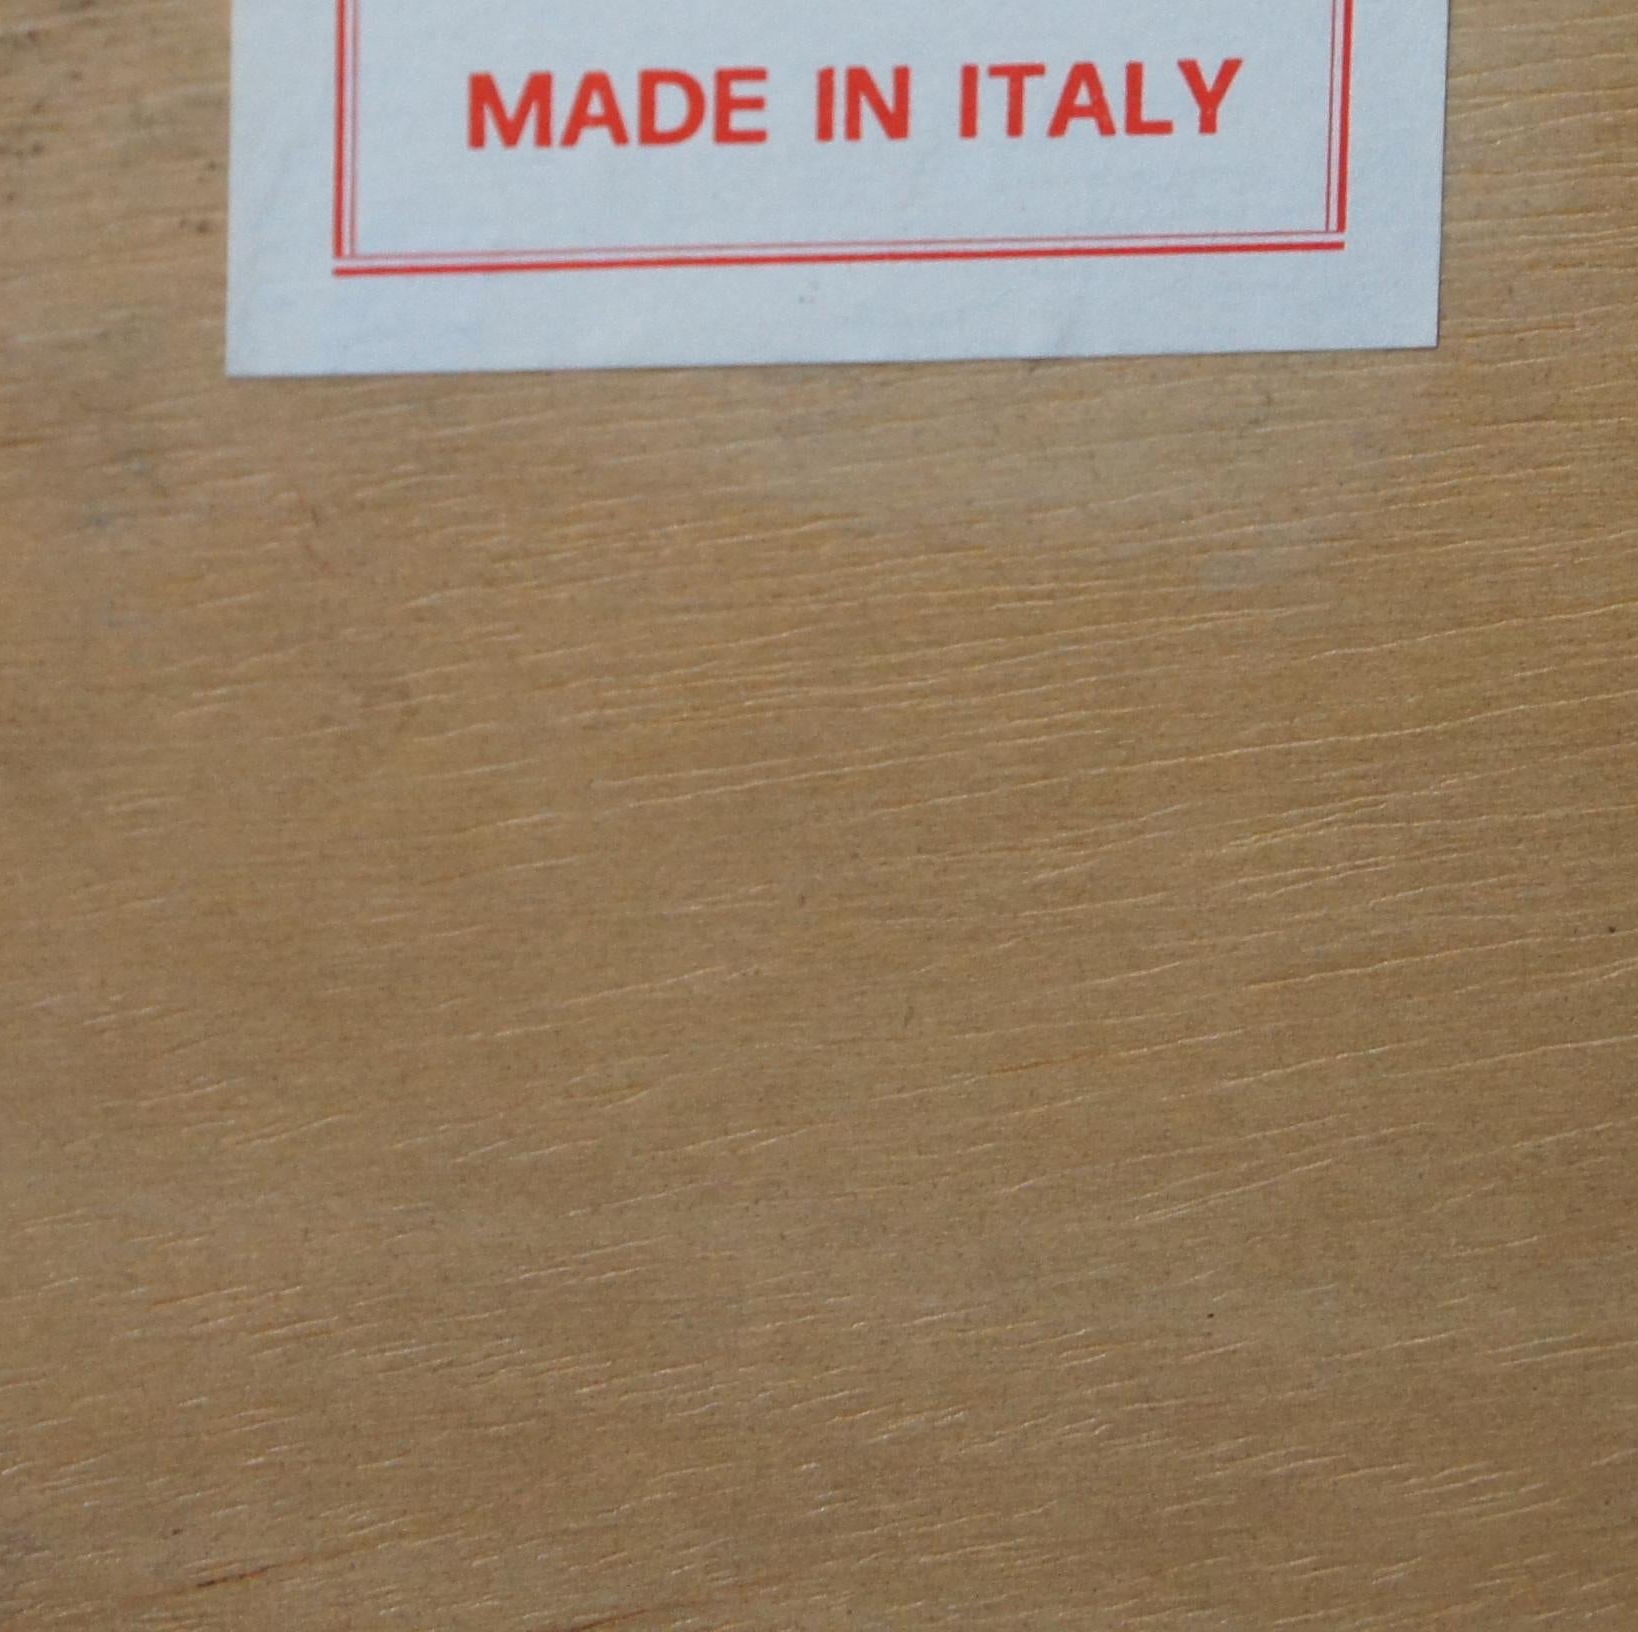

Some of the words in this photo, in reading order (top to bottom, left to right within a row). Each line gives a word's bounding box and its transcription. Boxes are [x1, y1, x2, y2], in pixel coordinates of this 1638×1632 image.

[466, 65, 770, 150] MADE
[815, 65, 913, 144] IN
[959, 57, 1245, 141] ITALY
